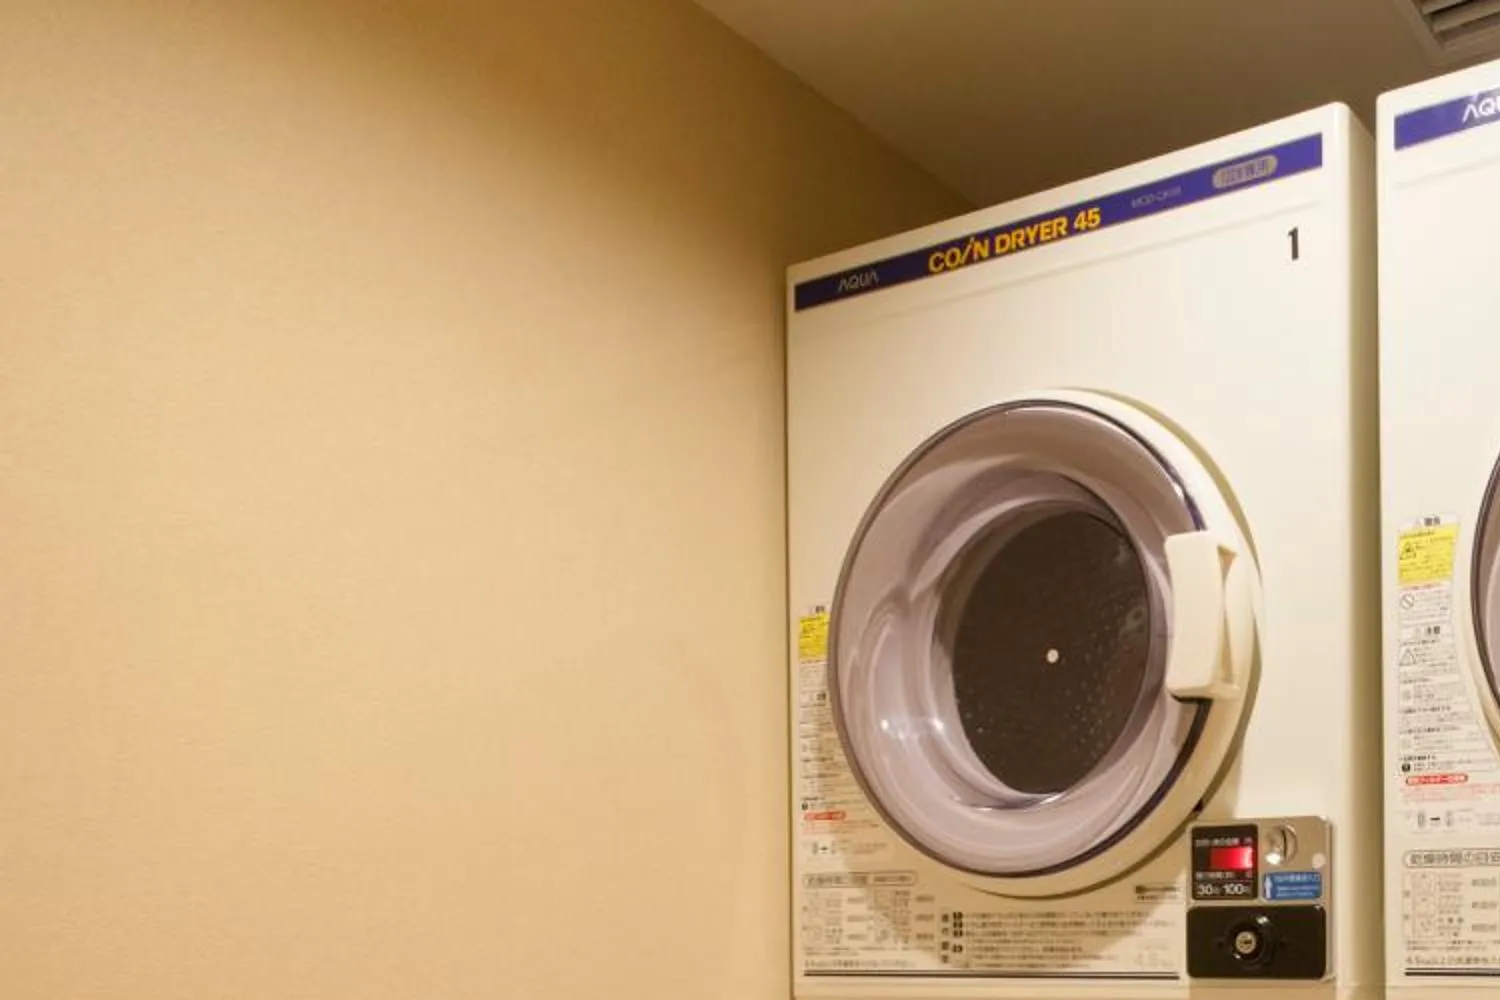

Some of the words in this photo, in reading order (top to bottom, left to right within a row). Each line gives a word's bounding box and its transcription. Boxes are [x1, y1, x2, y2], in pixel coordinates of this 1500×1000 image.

[838, 269, 879, 293] AQUA
[995, 216, 1069, 254] DRYER
[1073, 207, 1102, 231] 45
[1287, 226, 1299, 261] 1
